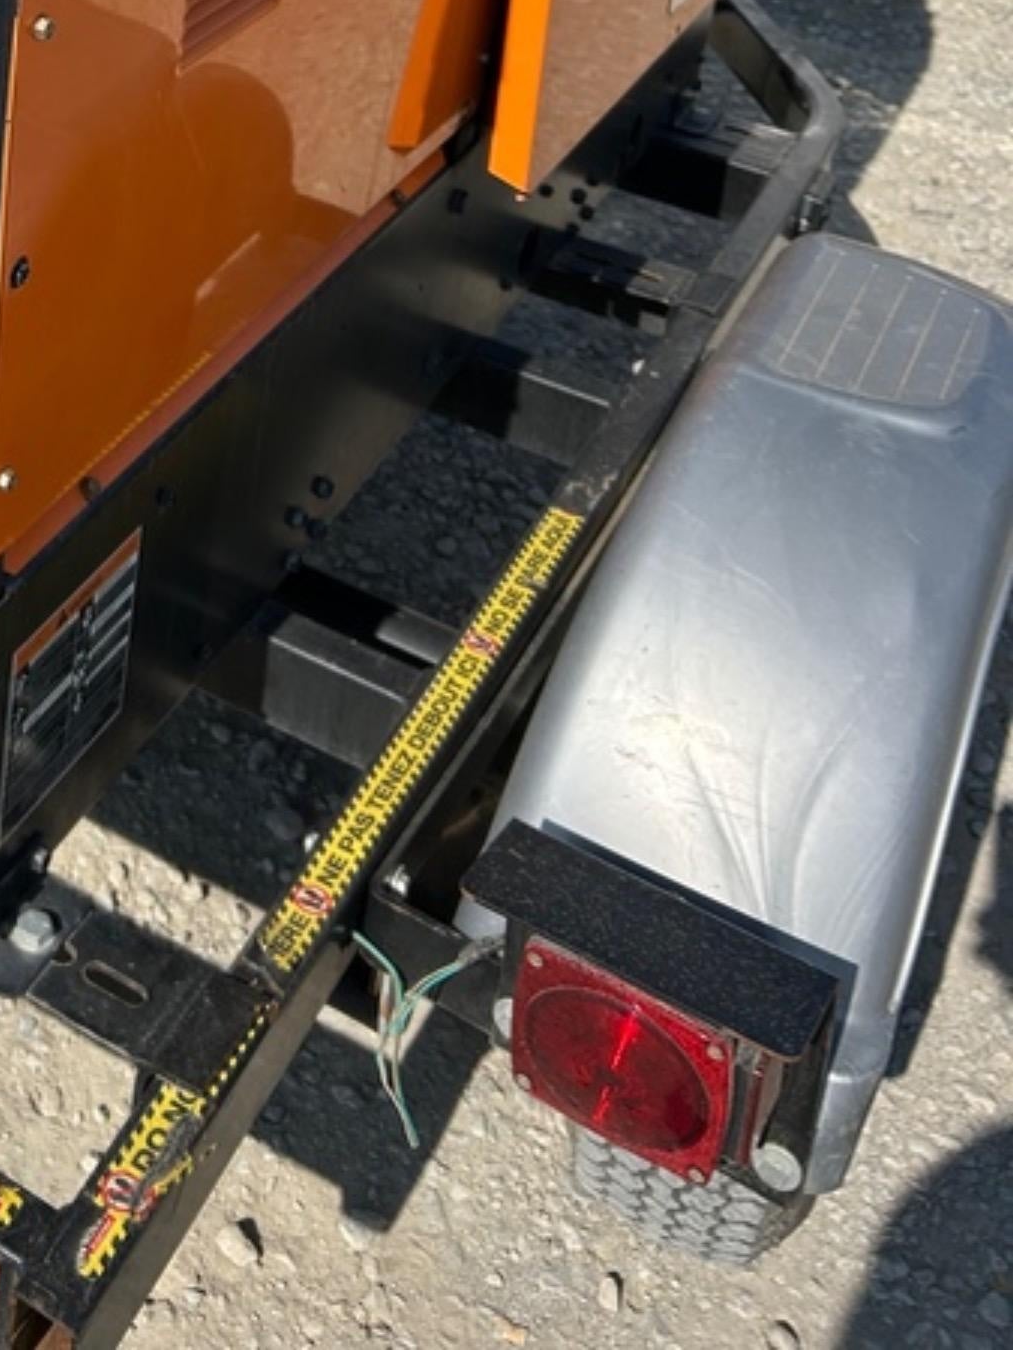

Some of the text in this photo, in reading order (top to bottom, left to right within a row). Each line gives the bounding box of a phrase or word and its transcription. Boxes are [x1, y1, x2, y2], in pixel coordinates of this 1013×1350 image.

[316, 852, 349, 886] NE
[338, 811, 376, 854] PAS
[364, 747, 418, 810] TENEZ
[406, 675, 464, 751] DEBOUT
